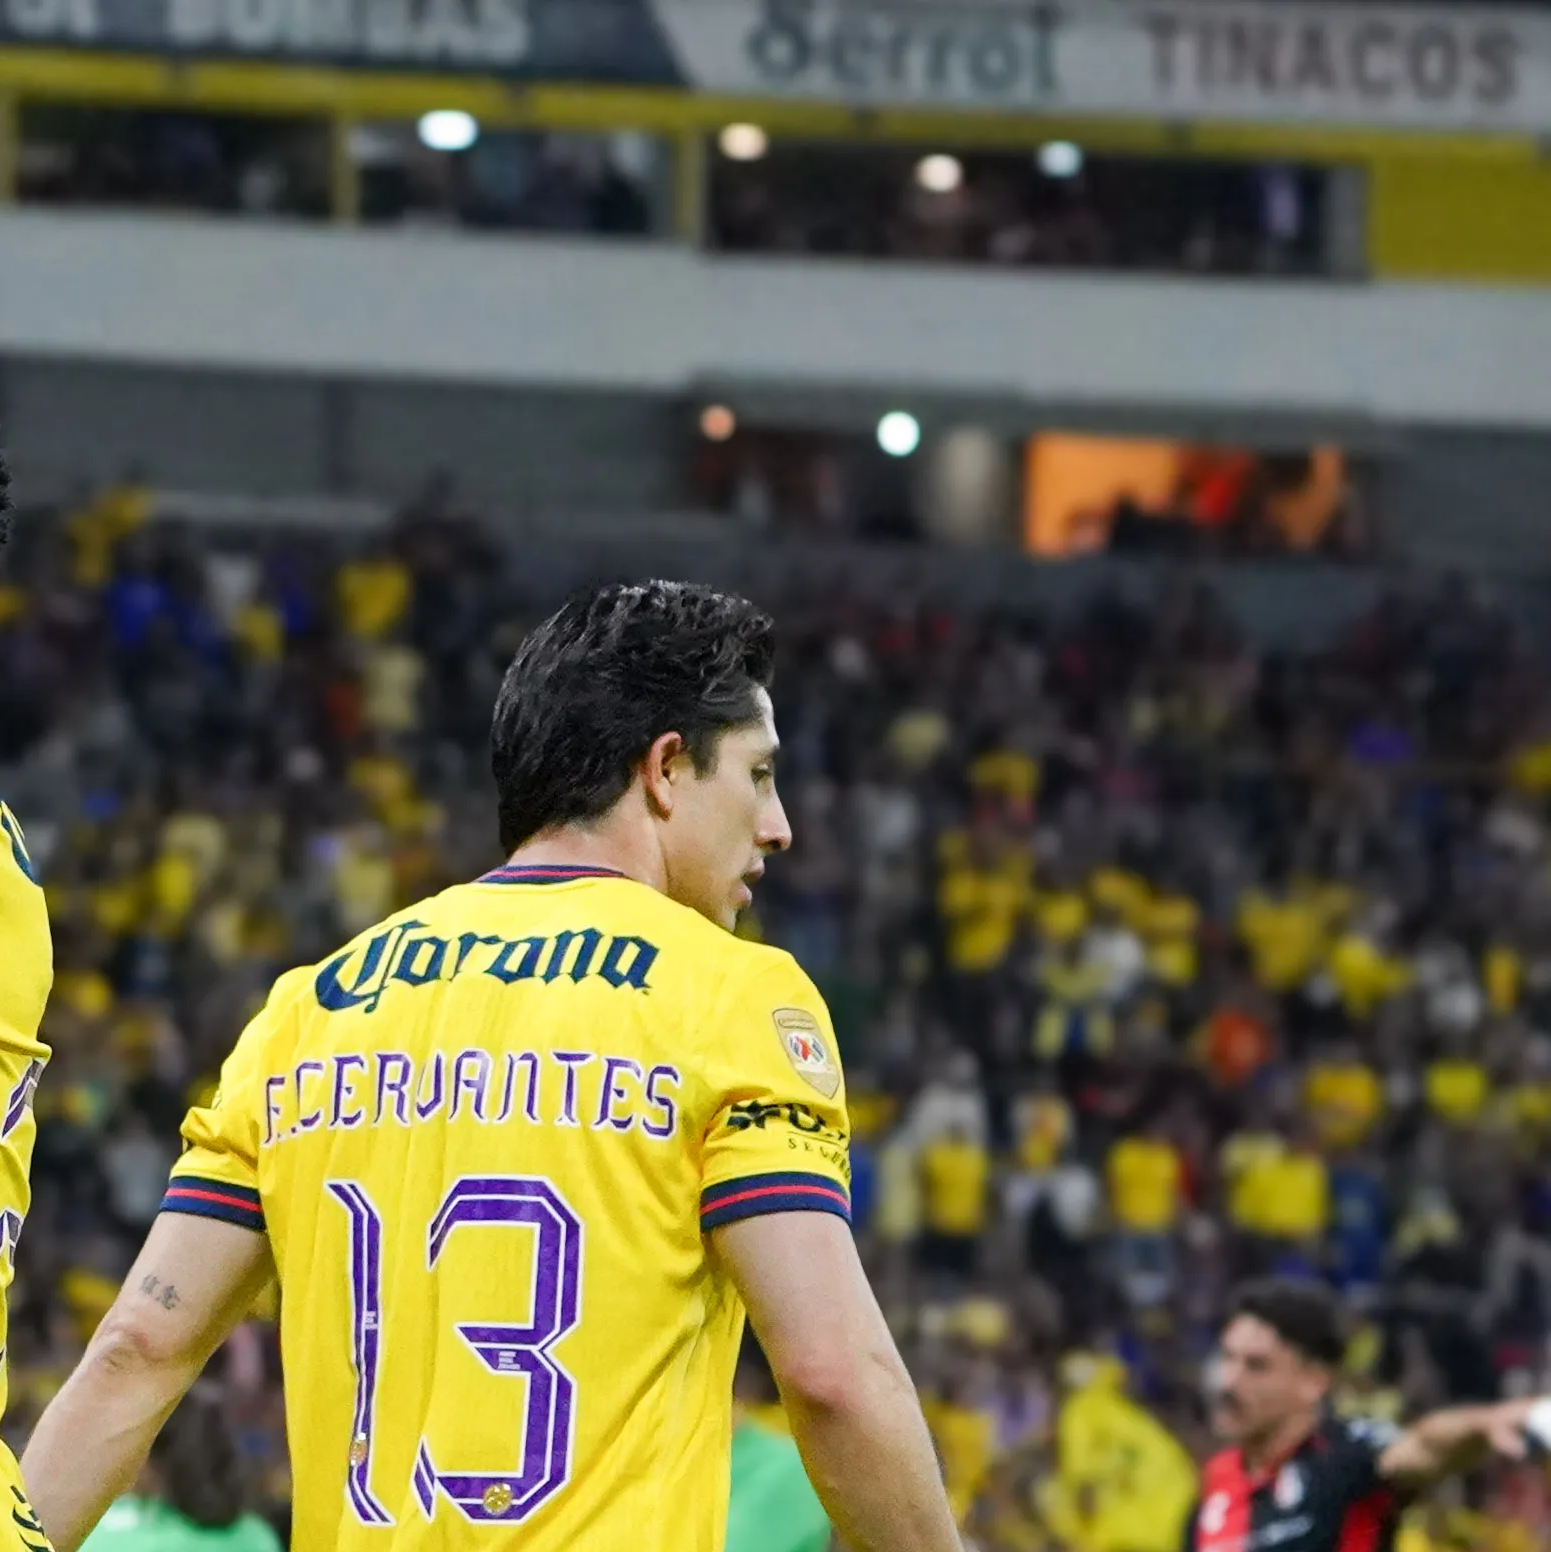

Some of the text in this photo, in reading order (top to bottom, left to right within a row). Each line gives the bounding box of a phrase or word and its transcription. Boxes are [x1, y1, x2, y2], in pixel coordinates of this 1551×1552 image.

[1143, 8, 1521, 104] TINACOS
[314, 918, 661, 1014] Corona
[323, 1174, 586, 1528] 13
